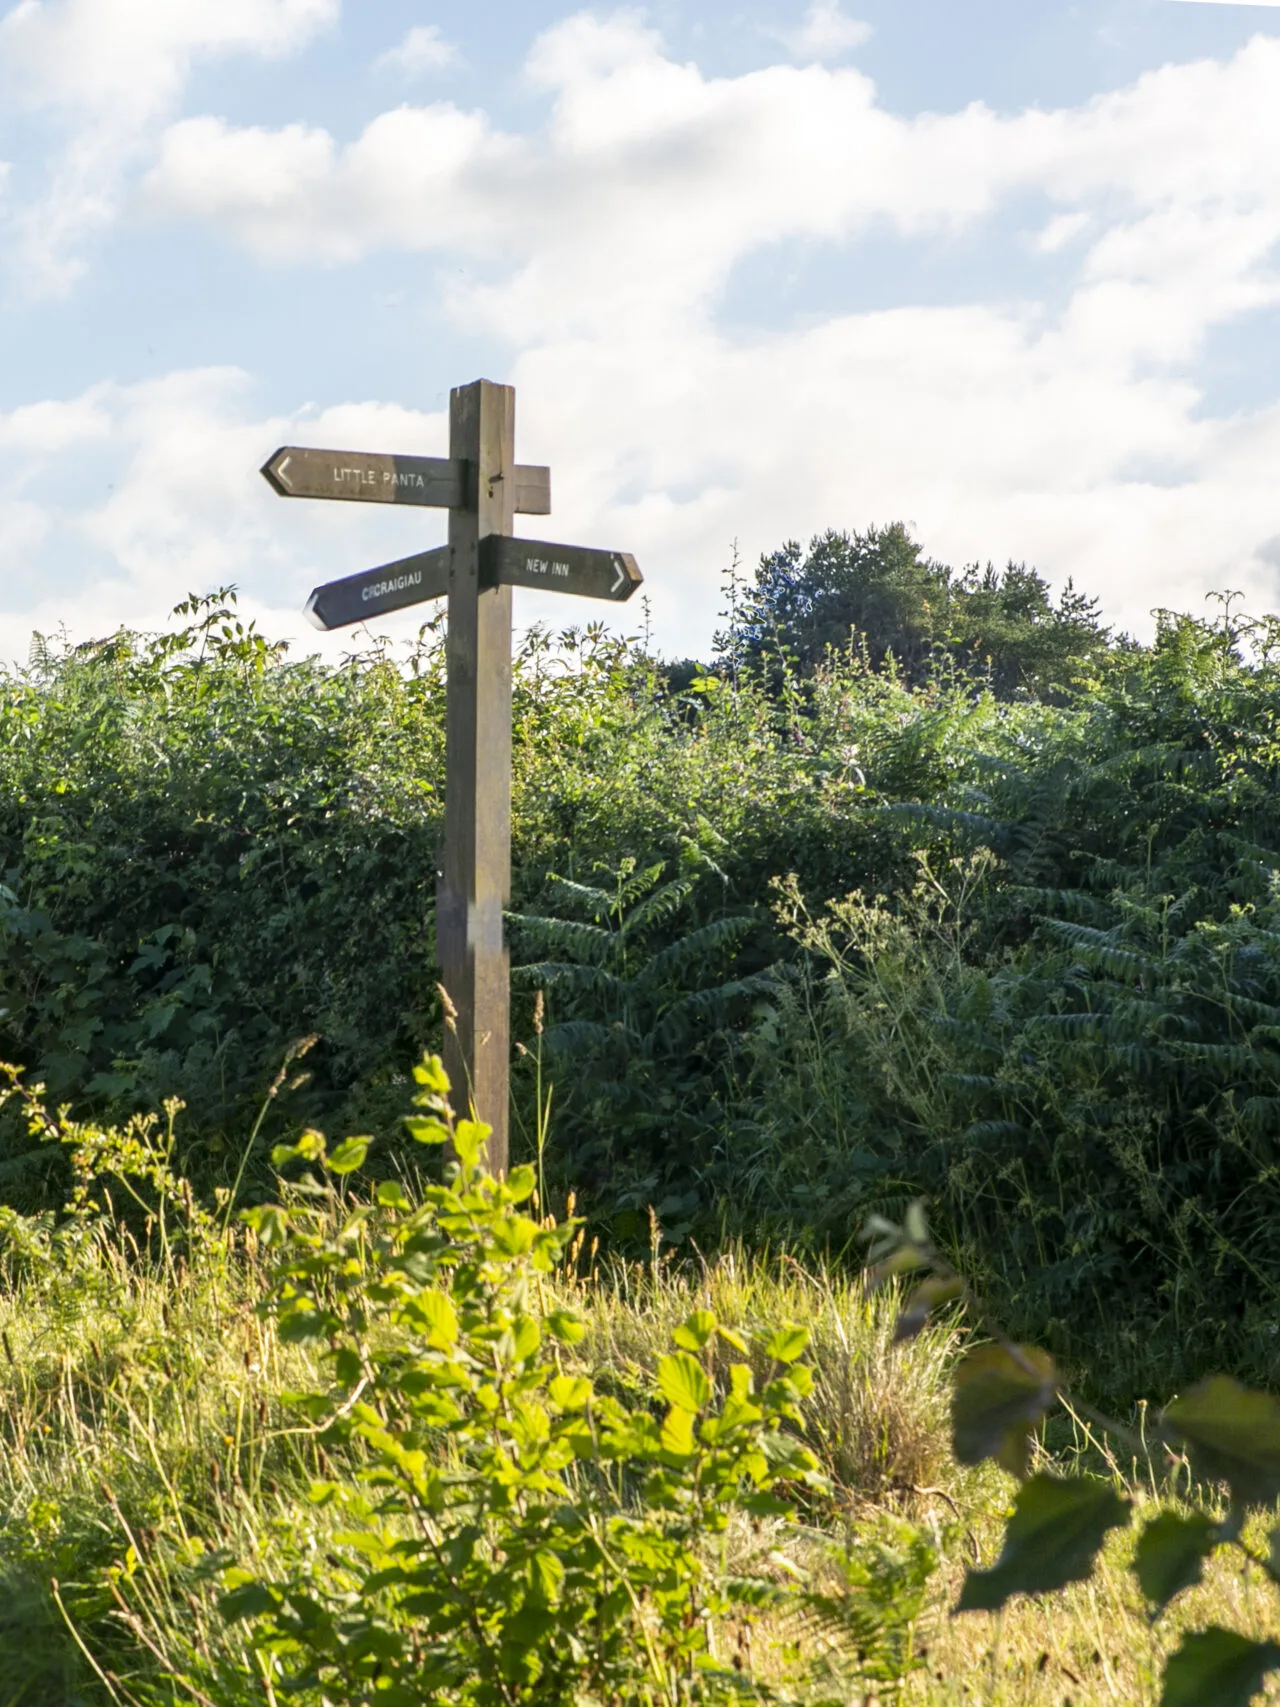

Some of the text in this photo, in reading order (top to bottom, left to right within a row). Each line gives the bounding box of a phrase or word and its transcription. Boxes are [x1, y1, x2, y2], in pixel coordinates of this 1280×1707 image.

[333, 468, 424, 488] LITTLE PANTA
[526, 558, 570, 577] NEW INN
